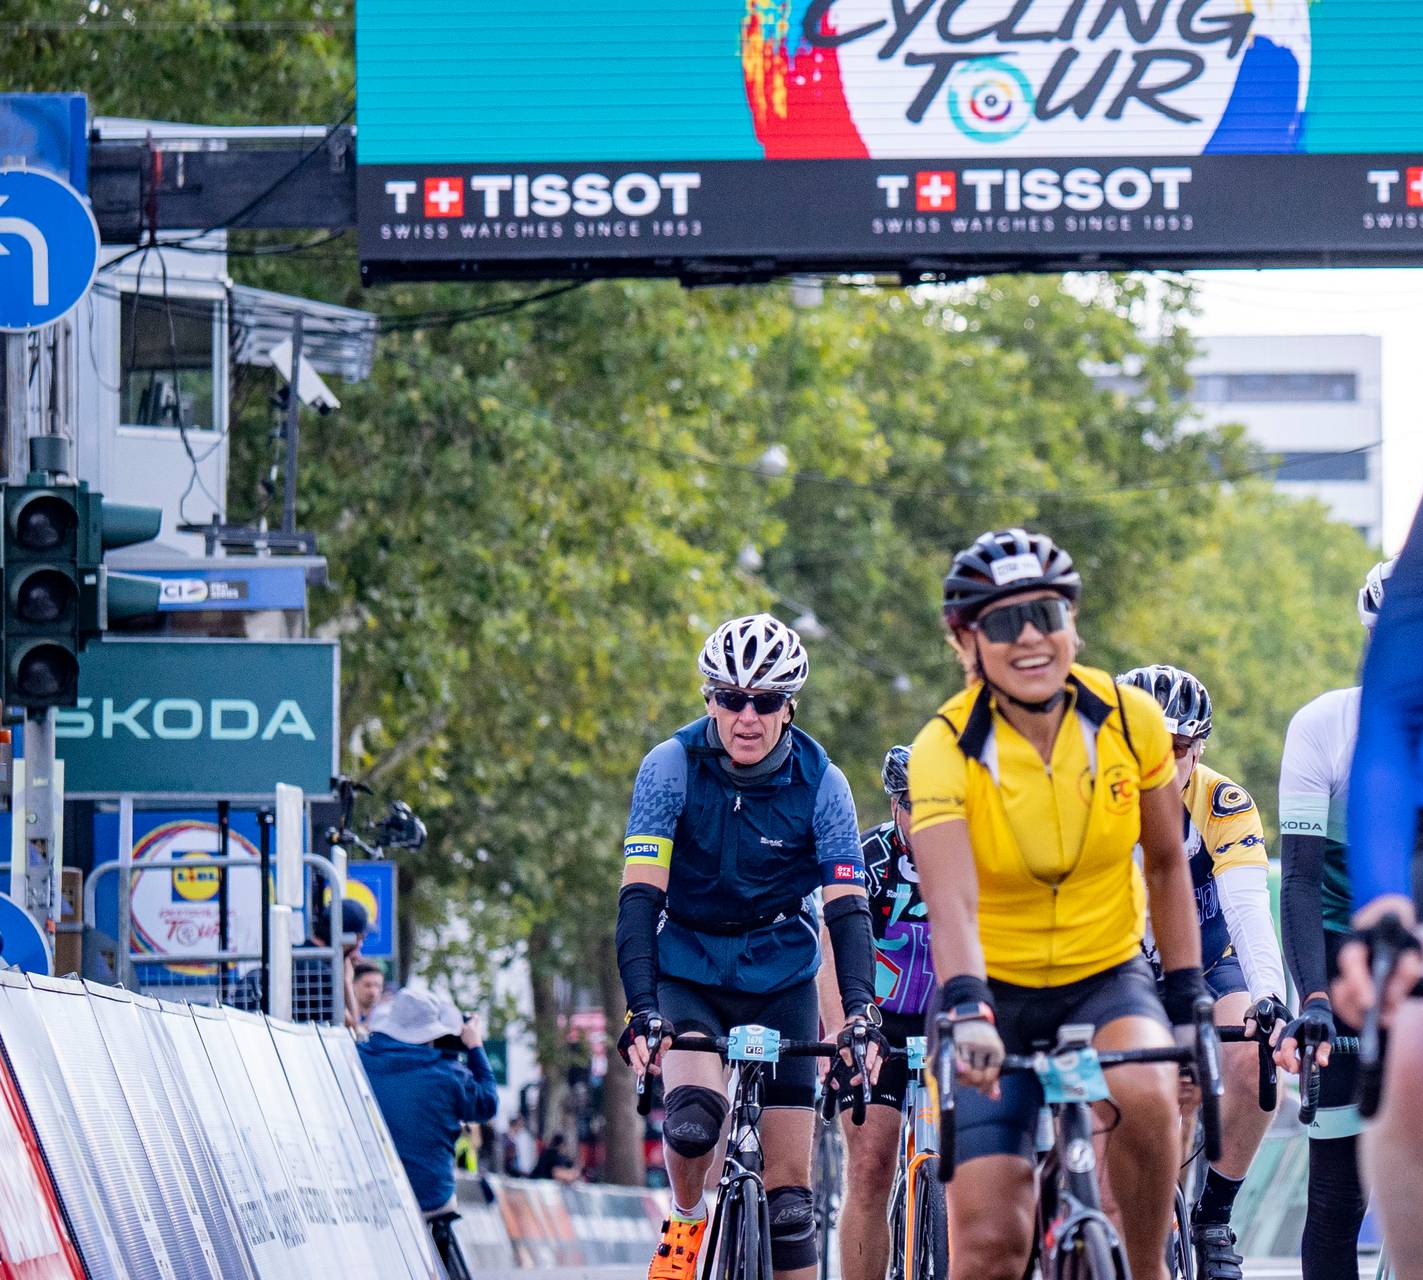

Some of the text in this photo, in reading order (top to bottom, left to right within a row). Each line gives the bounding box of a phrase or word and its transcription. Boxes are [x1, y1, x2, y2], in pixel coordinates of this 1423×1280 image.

[802, 0, 1256, 60] CYCLING
[904, 47, 1206, 143] TOUR
[471, 172, 701, 217] TISSOT
[962, 167, 1192, 212] TISSOT
[380, 222, 449, 239] SWISS
[460, 221, 563, 239] WATCHES
[574, 220, 641, 238] SINCE
[872, 216, 941, 234] SWISS
[951, 216, 1055, 233] WATCHES
[1064, 215, 1132, 232] SINCE
[1280, 821, 1323, 831] KODA
[625, 844, 658, 856] ÖLDEN
